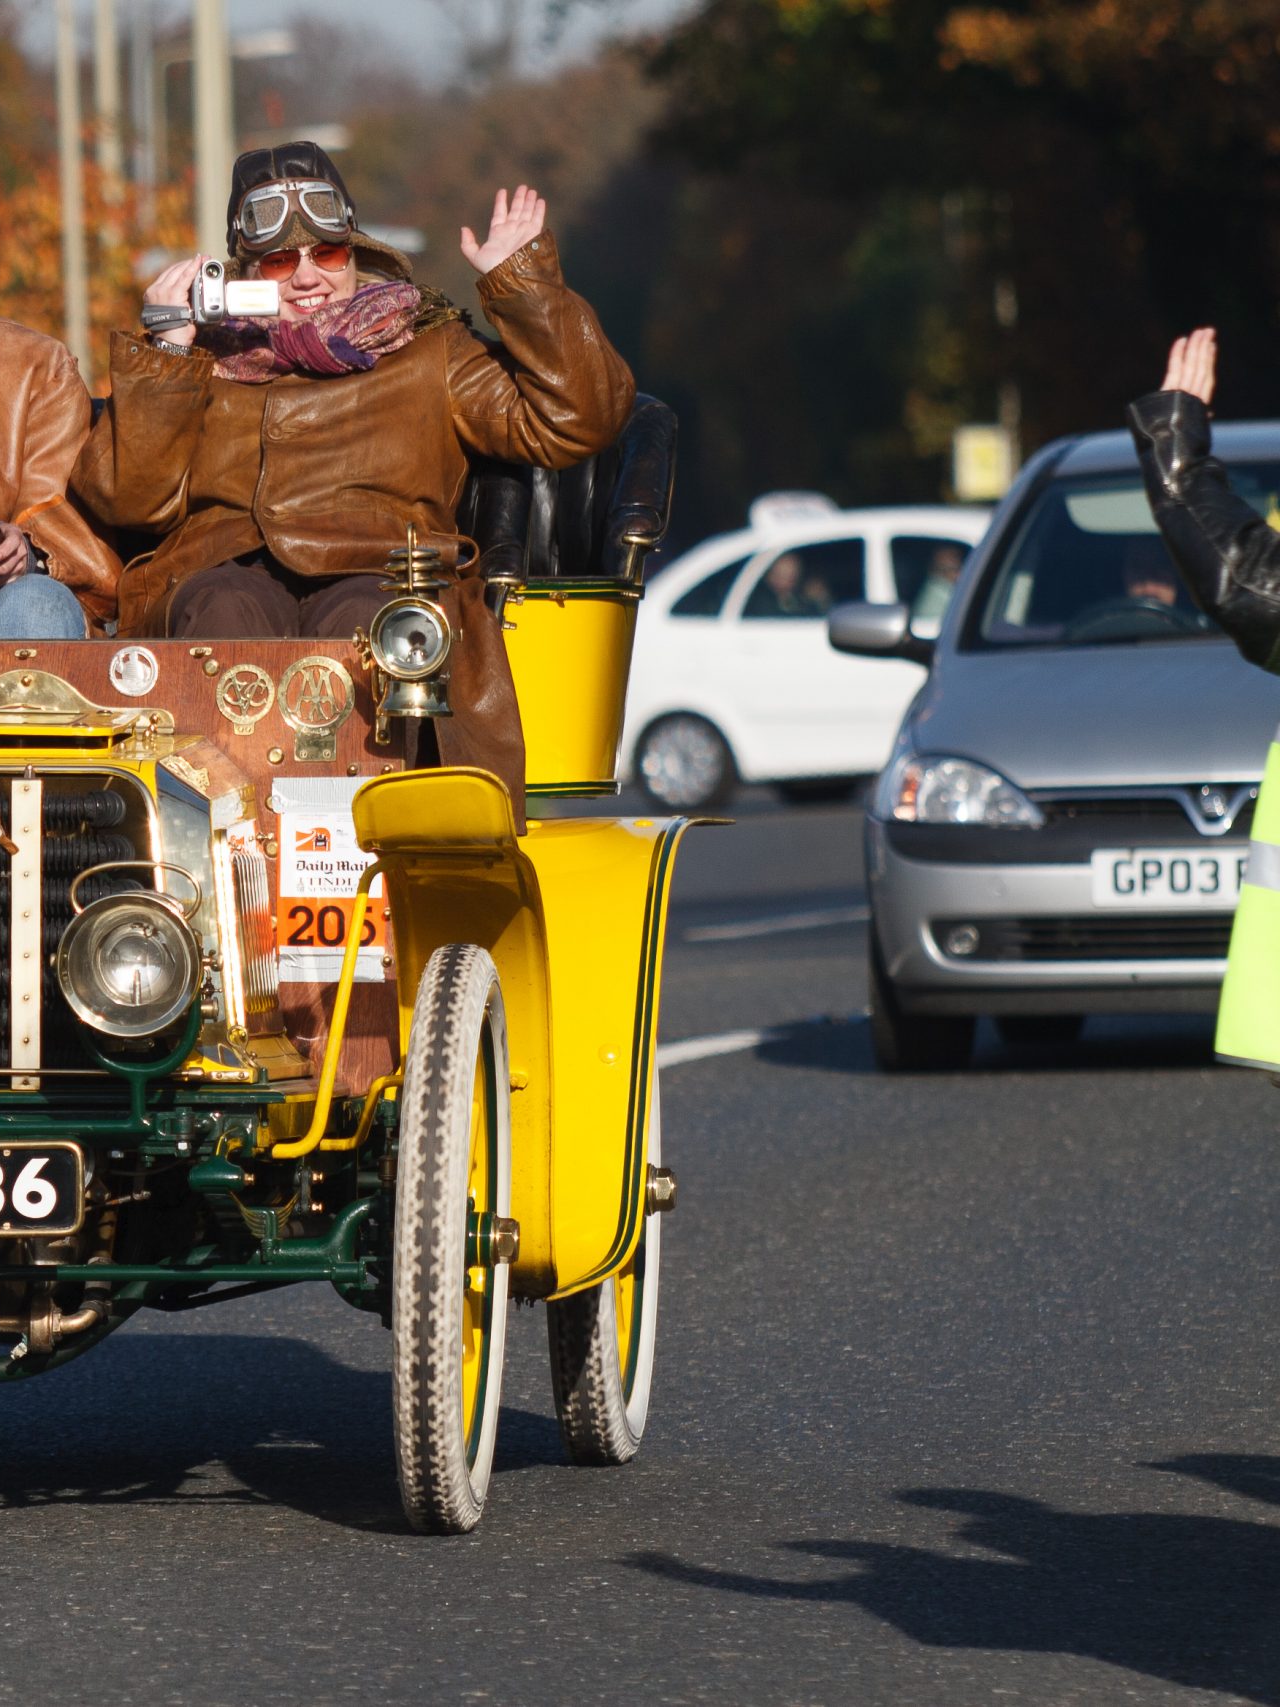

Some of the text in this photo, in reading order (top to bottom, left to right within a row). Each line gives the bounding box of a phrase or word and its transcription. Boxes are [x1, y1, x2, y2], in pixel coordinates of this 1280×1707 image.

[152, 313, 171, 321] SONY
[296, 860, 369, 875] Daily Mail
[1113, 858, 1219, 894] GP03
[287, 905, 376, 947] 205
